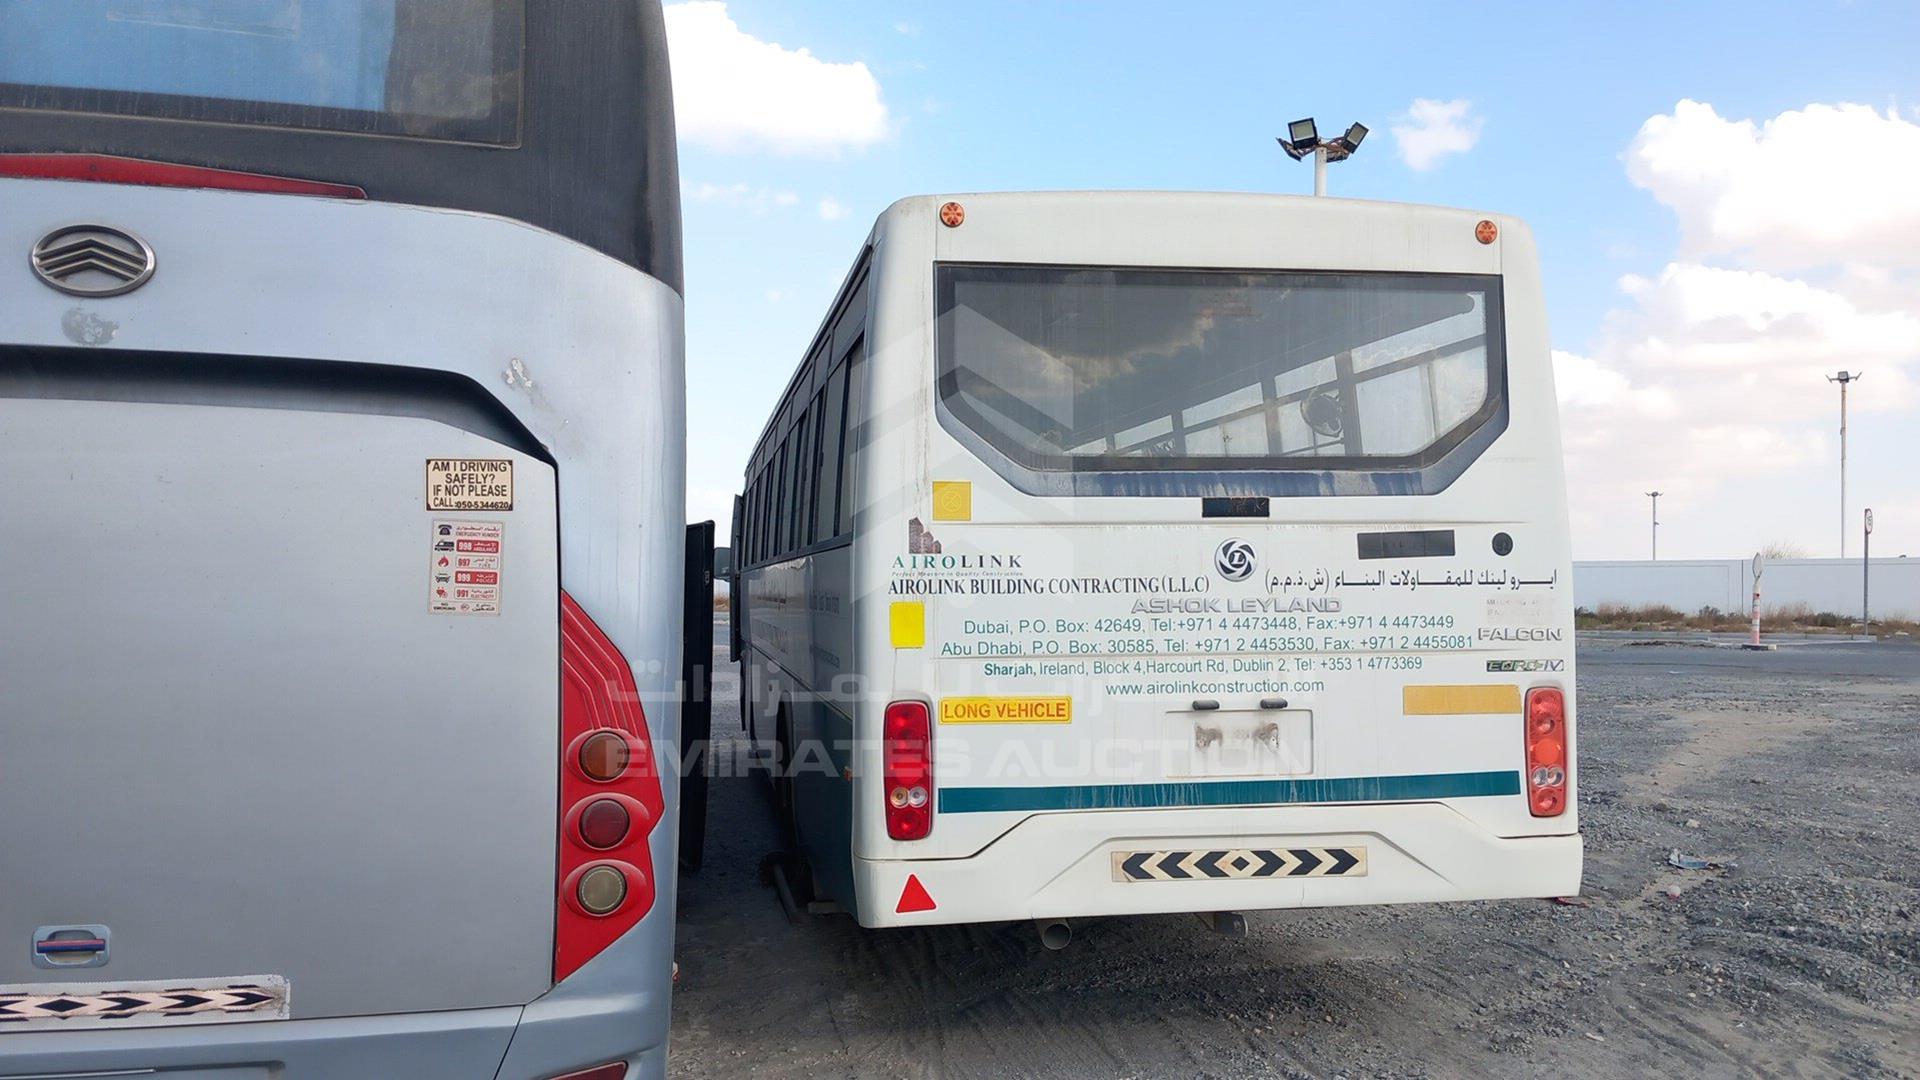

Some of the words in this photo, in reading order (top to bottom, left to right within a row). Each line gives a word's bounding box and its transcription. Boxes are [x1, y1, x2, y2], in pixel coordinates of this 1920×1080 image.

[432, 462, 450, 472] AM
[460, 462, 507, 472] DRIVING
[445, 473, 496, 484] SAFELY?
[433, 485, 442, 496] IF
[444, 485, 466, 496] NOT
[468, 485, 507, 496] PLEASE
[892, 555, 1022, 569] AIROLINK
[456, 589, 469, 597] 991
[888, 578, 965, 595] AIROLINK
[970, 578, 1044, 595] BUILDING
[1131, 598, 1221, 614] ASHOK
[1227, 597, 1342, 613] LEYLAND
[964, 620, 1014, 635] Dubai,
[1019, 619, 1050, 633] P.O.
[1056, 619, 1089, 633] Box:
[1094, 618, 1146, 633] 42649,
[1218, 618, 1228, 631] 4
[1232, 617, 1302, 632] 4473448,
[1379, 616, 1388, 629] 4
[1392, 615, 1454, 629] 4473449
[1478, 627, 1563, 641] FALCON
[941, 640, 972, 656] Abu
[977, 640, 1026, 657] Dhabi,
[1032, 640, 1062, 655] P.O.
[1069, 640, 1100, 654] Box:
[1107, 639, 1158, 656] 30585,
[1164, 639, 1189, 654] Tel:
[1195, 639, 1230, 653] +971
[1236, 638, 1246, 652] 2
[1250, 638, 1318, 652] 4453530,
[1324, 637, 1354, 650] Fax:
[1360, 636, 1394, 649] +971
[1400, 636, 1409, 649] 2
[1413, 635, 1473, 649] 4455081
[984, 663, 1037, 677] Sharjah,
[1039, 662, 1089, 676] Ireland,
[1093, 660, 1130, 675] Block
[1206, 660, 1228, 674] Rd,
[1233, 659, 1274, 673] Dublin
[1294, 658, 1316, 671] Tel:
[1320, 657, 1353, 671] +353
[1367, 656, 1423, 671] 4773369
[1105, 679, 1324, 695] www.airolinkconstruction.com
[944, 703, 991, 718] LONG
[996, 702, 1066, 718] VEHICLE
